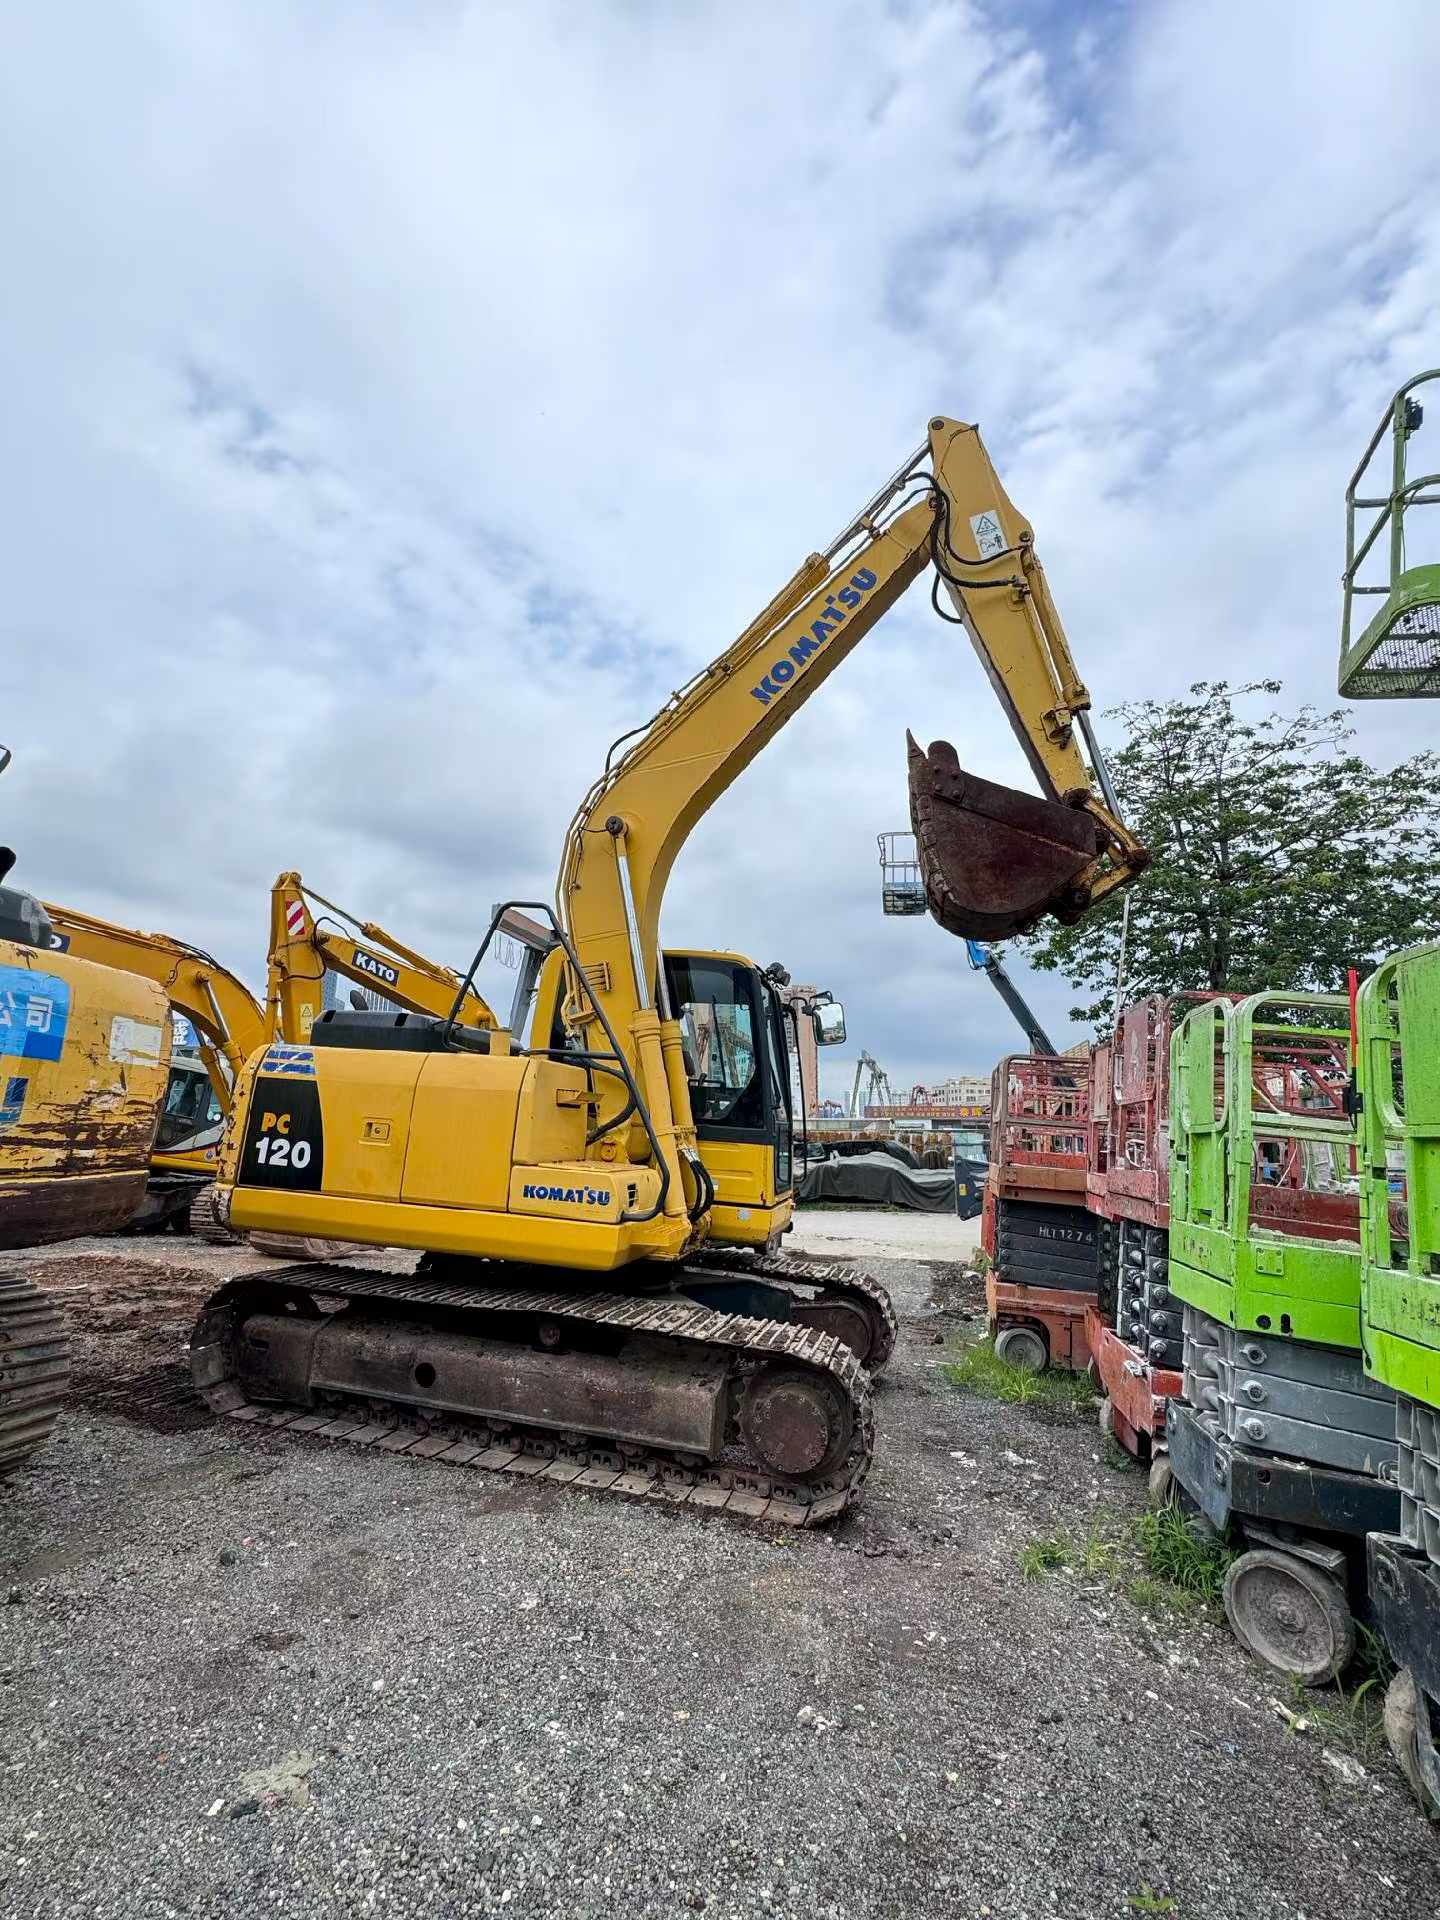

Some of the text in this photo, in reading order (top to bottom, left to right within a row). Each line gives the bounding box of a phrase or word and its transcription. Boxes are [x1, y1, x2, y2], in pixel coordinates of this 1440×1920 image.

[750, 567, 877, 705] KOMATSU
[356, 952, 395, 982] KATO
[261, 1112, 290, 1134] PC
[256, 1137, 311, 1168] 120
[523, 1184, 610, 1206] KOMATSU
